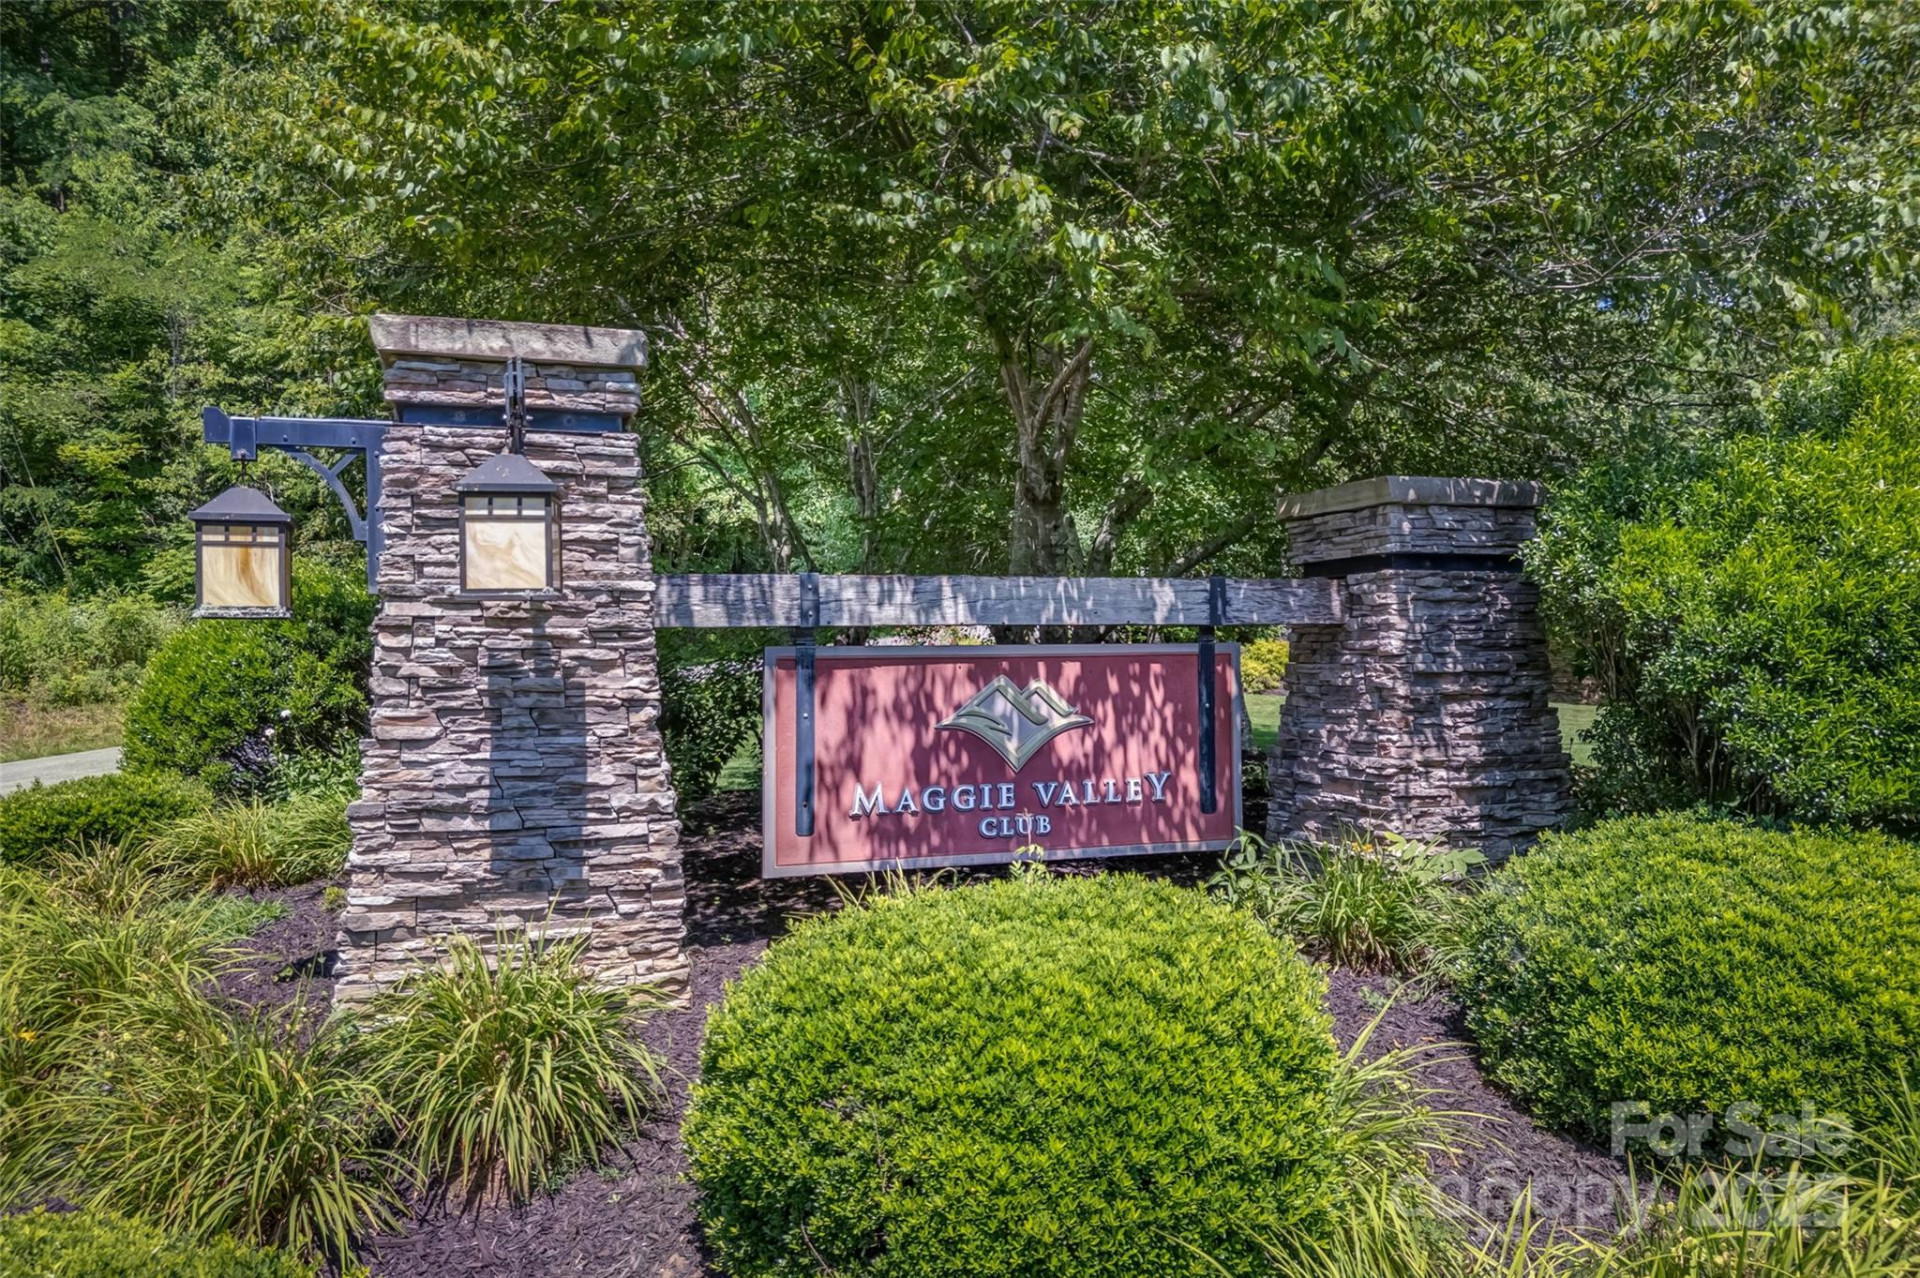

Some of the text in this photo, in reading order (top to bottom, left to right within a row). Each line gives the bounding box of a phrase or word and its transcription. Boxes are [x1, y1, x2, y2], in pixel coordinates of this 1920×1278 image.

[849, 771, 1171, 820] MAGGIE VALLEY
[979, 815, 1052, 838] CLUB
